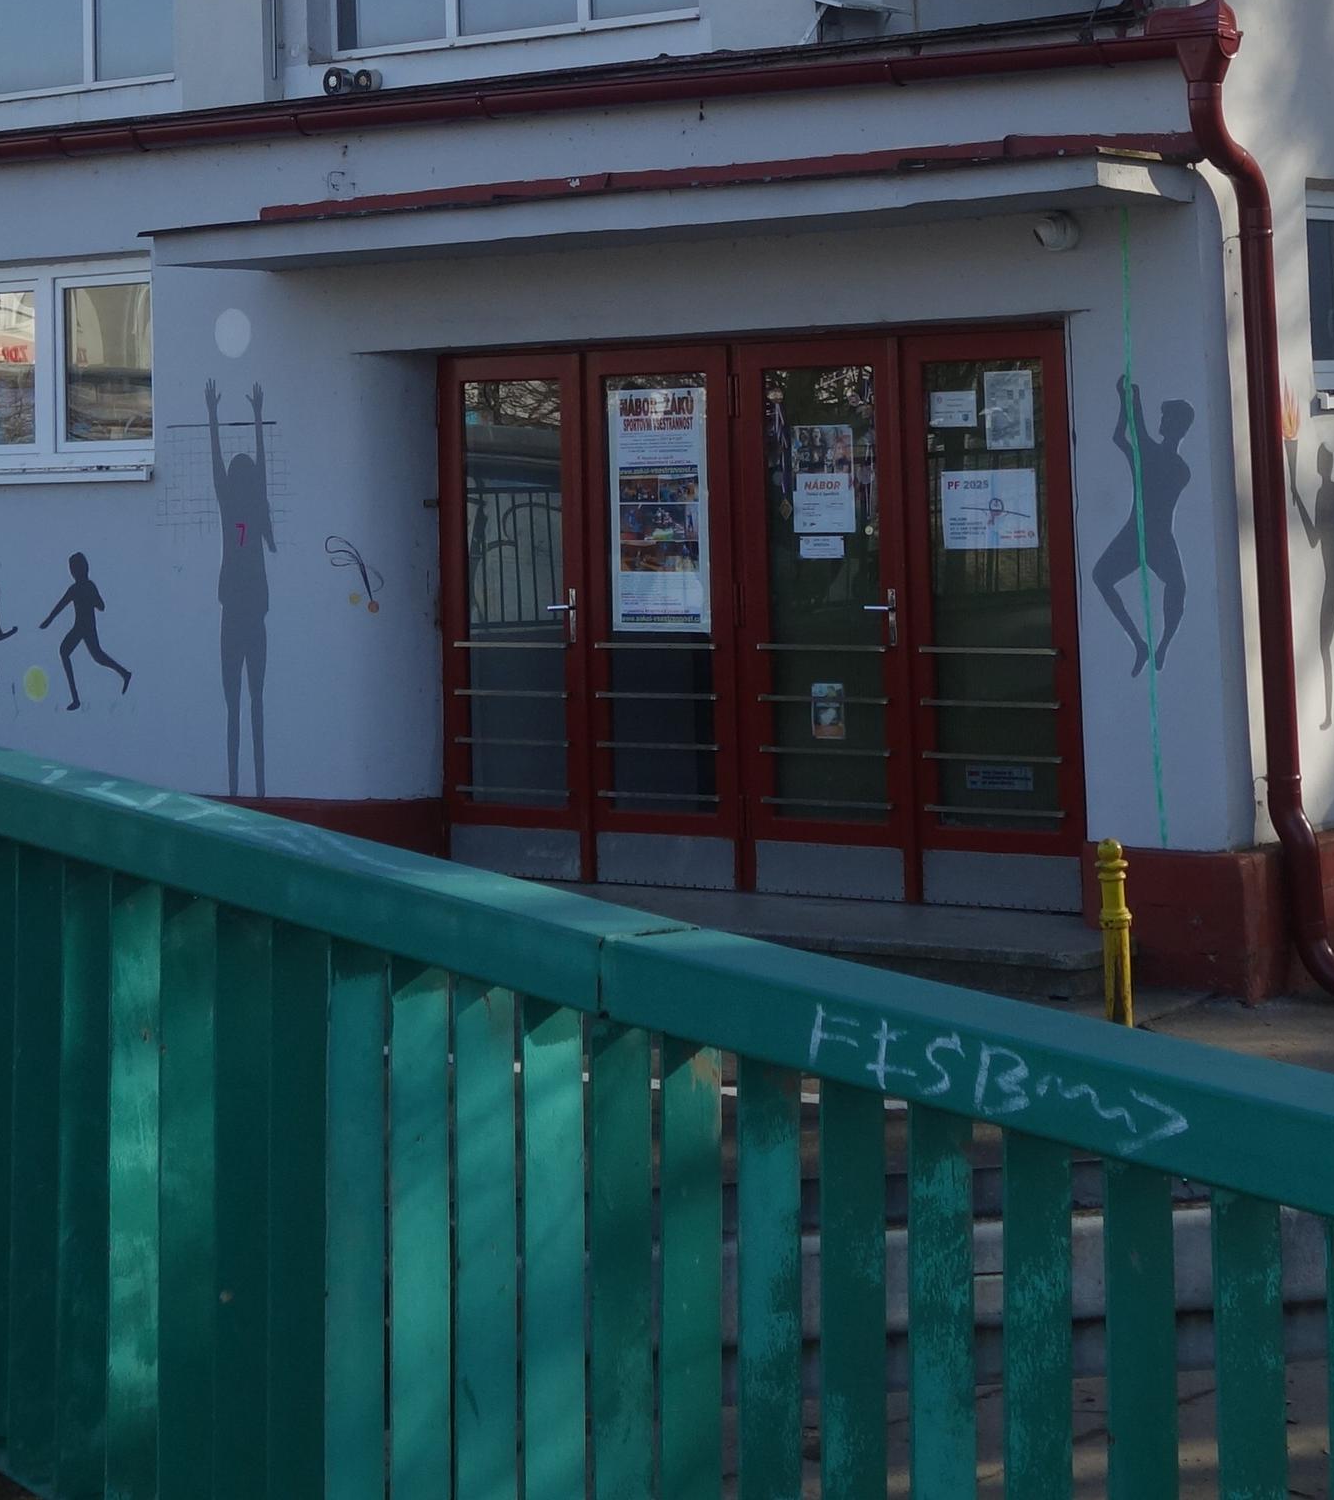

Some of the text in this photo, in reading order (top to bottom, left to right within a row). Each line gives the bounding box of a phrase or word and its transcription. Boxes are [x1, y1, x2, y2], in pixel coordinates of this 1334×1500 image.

[804, 478, 841, 490] NÁBOR
[947, 481, 961, 490] PF
[235, 523, 246, 547] 7
